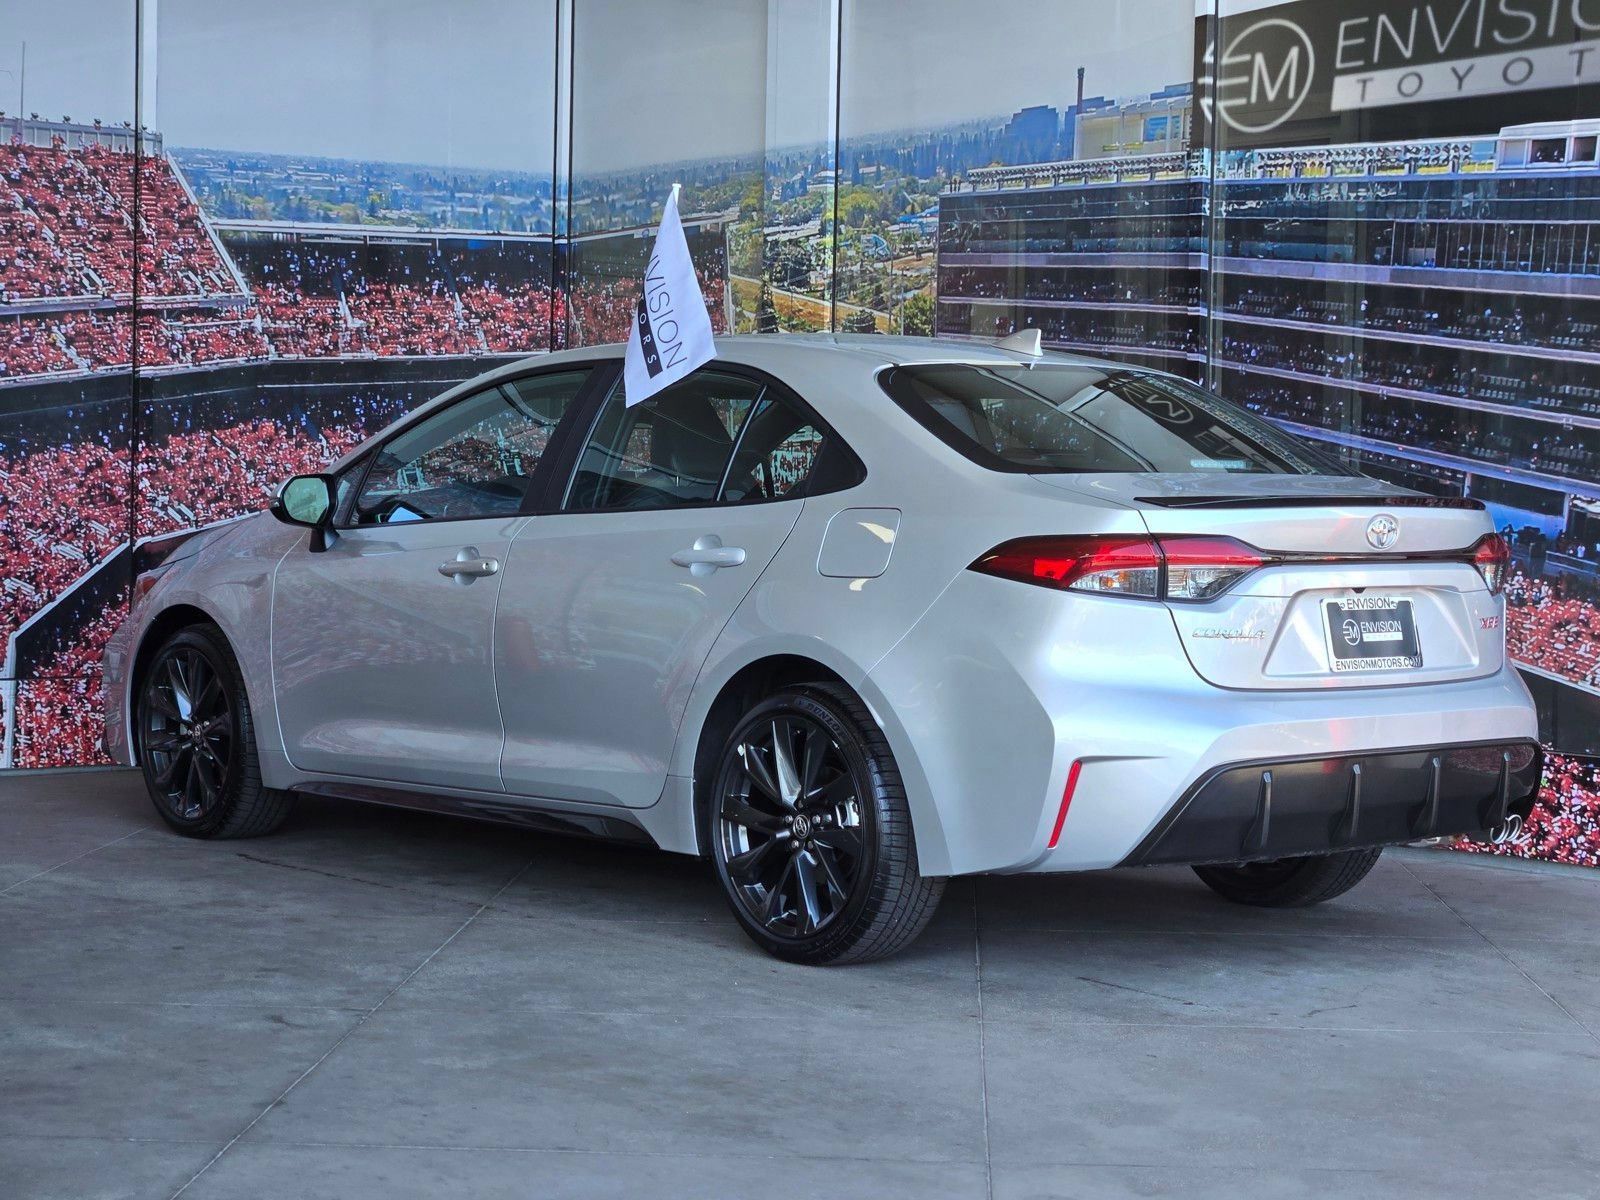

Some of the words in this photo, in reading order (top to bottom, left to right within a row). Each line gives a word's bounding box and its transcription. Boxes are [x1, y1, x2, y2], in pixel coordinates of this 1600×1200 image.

[1335, 0, 1600, 69] ENVISI
[1346, 598, 1391, 610] ENVISION
[1360, 620, 1402, 633] ENVISION
